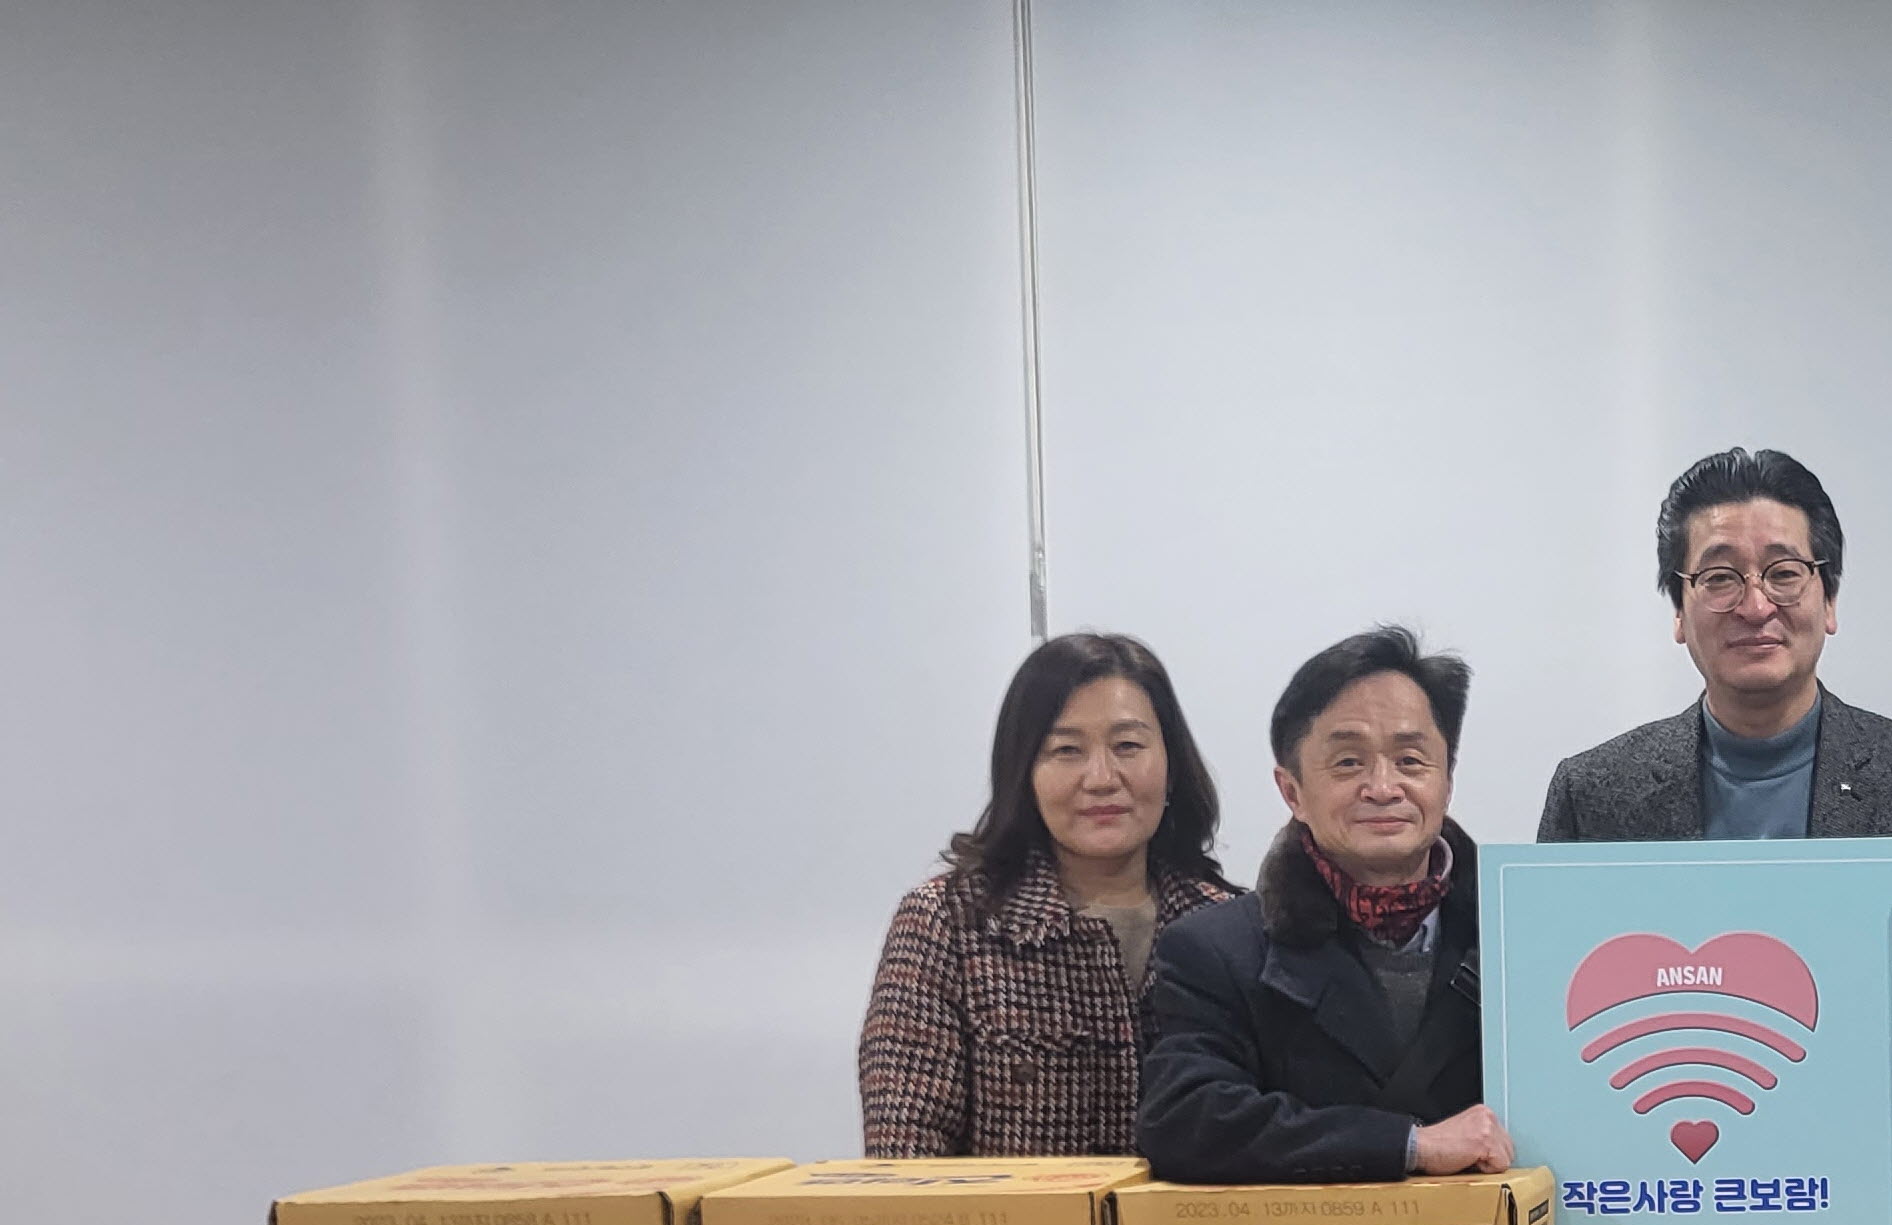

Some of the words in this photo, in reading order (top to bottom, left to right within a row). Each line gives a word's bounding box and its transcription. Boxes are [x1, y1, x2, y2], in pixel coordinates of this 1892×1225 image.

[1656, 965, 1724, 987] ANSAN
[1562, 1179, 1704, 1214] 작은사랑
[1713, 1177, 1830, 1212] 큰보람!
